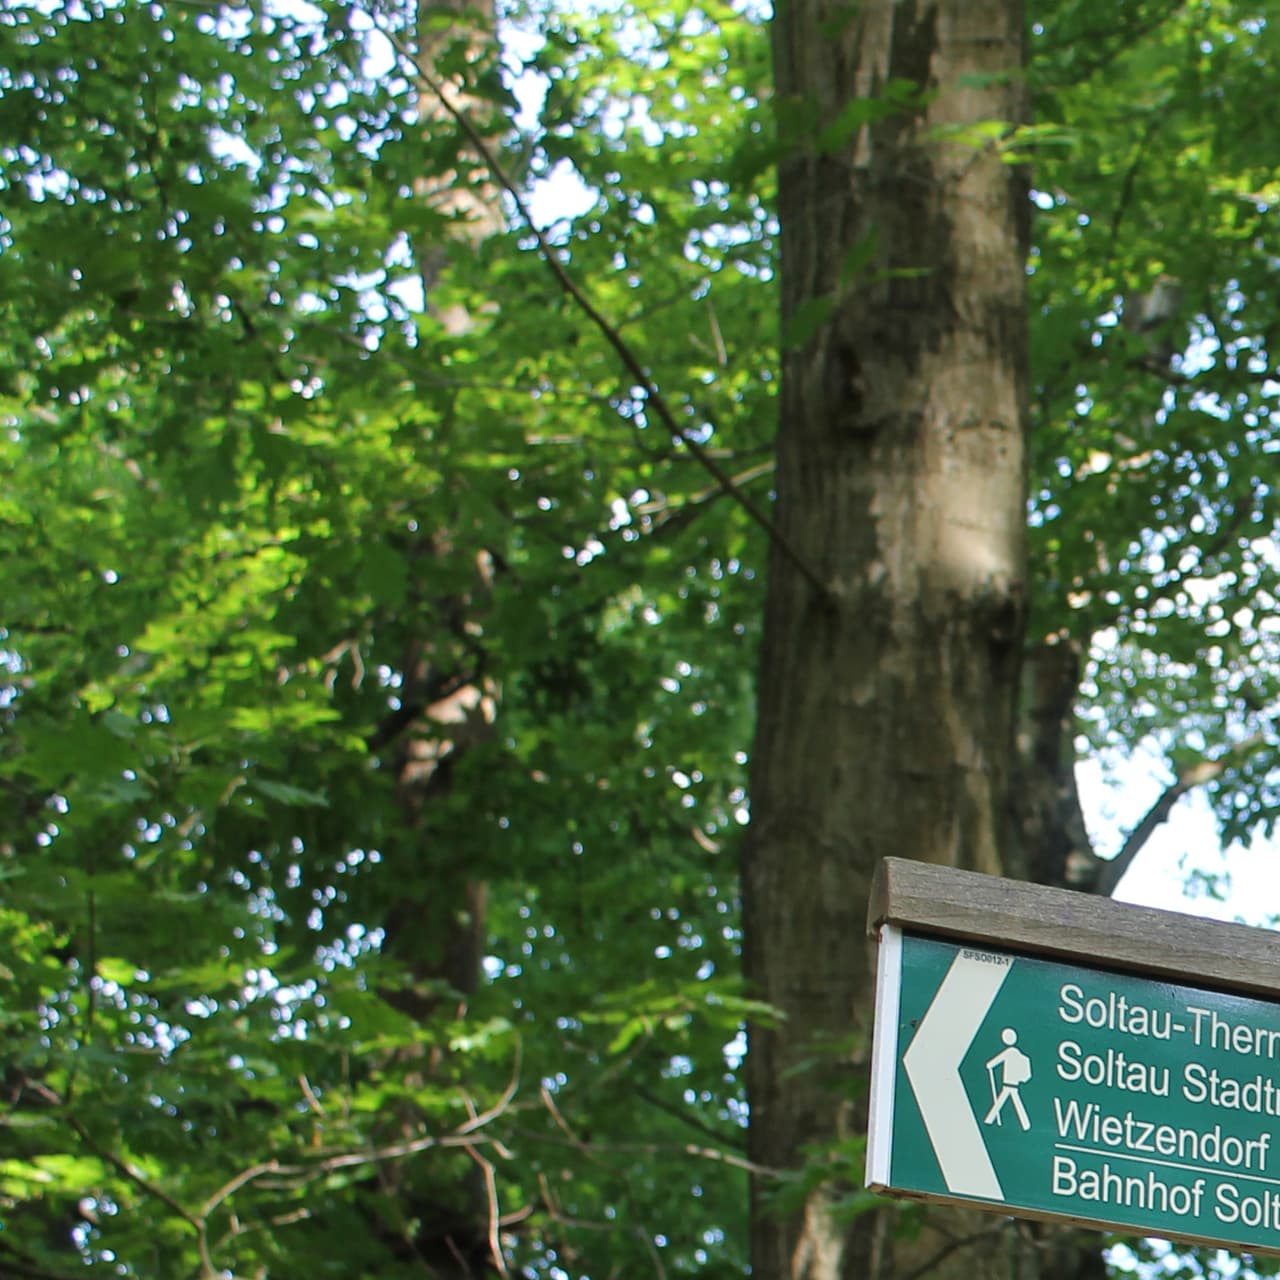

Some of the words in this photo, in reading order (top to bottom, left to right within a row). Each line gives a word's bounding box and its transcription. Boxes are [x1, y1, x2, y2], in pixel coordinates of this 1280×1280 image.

[1056, 1041, 1169, 1096] Soltau
[1053, 1097, 1271, 1170] Wietzendorf
[1052, 1156, 1205, 1217] Bahnhof
